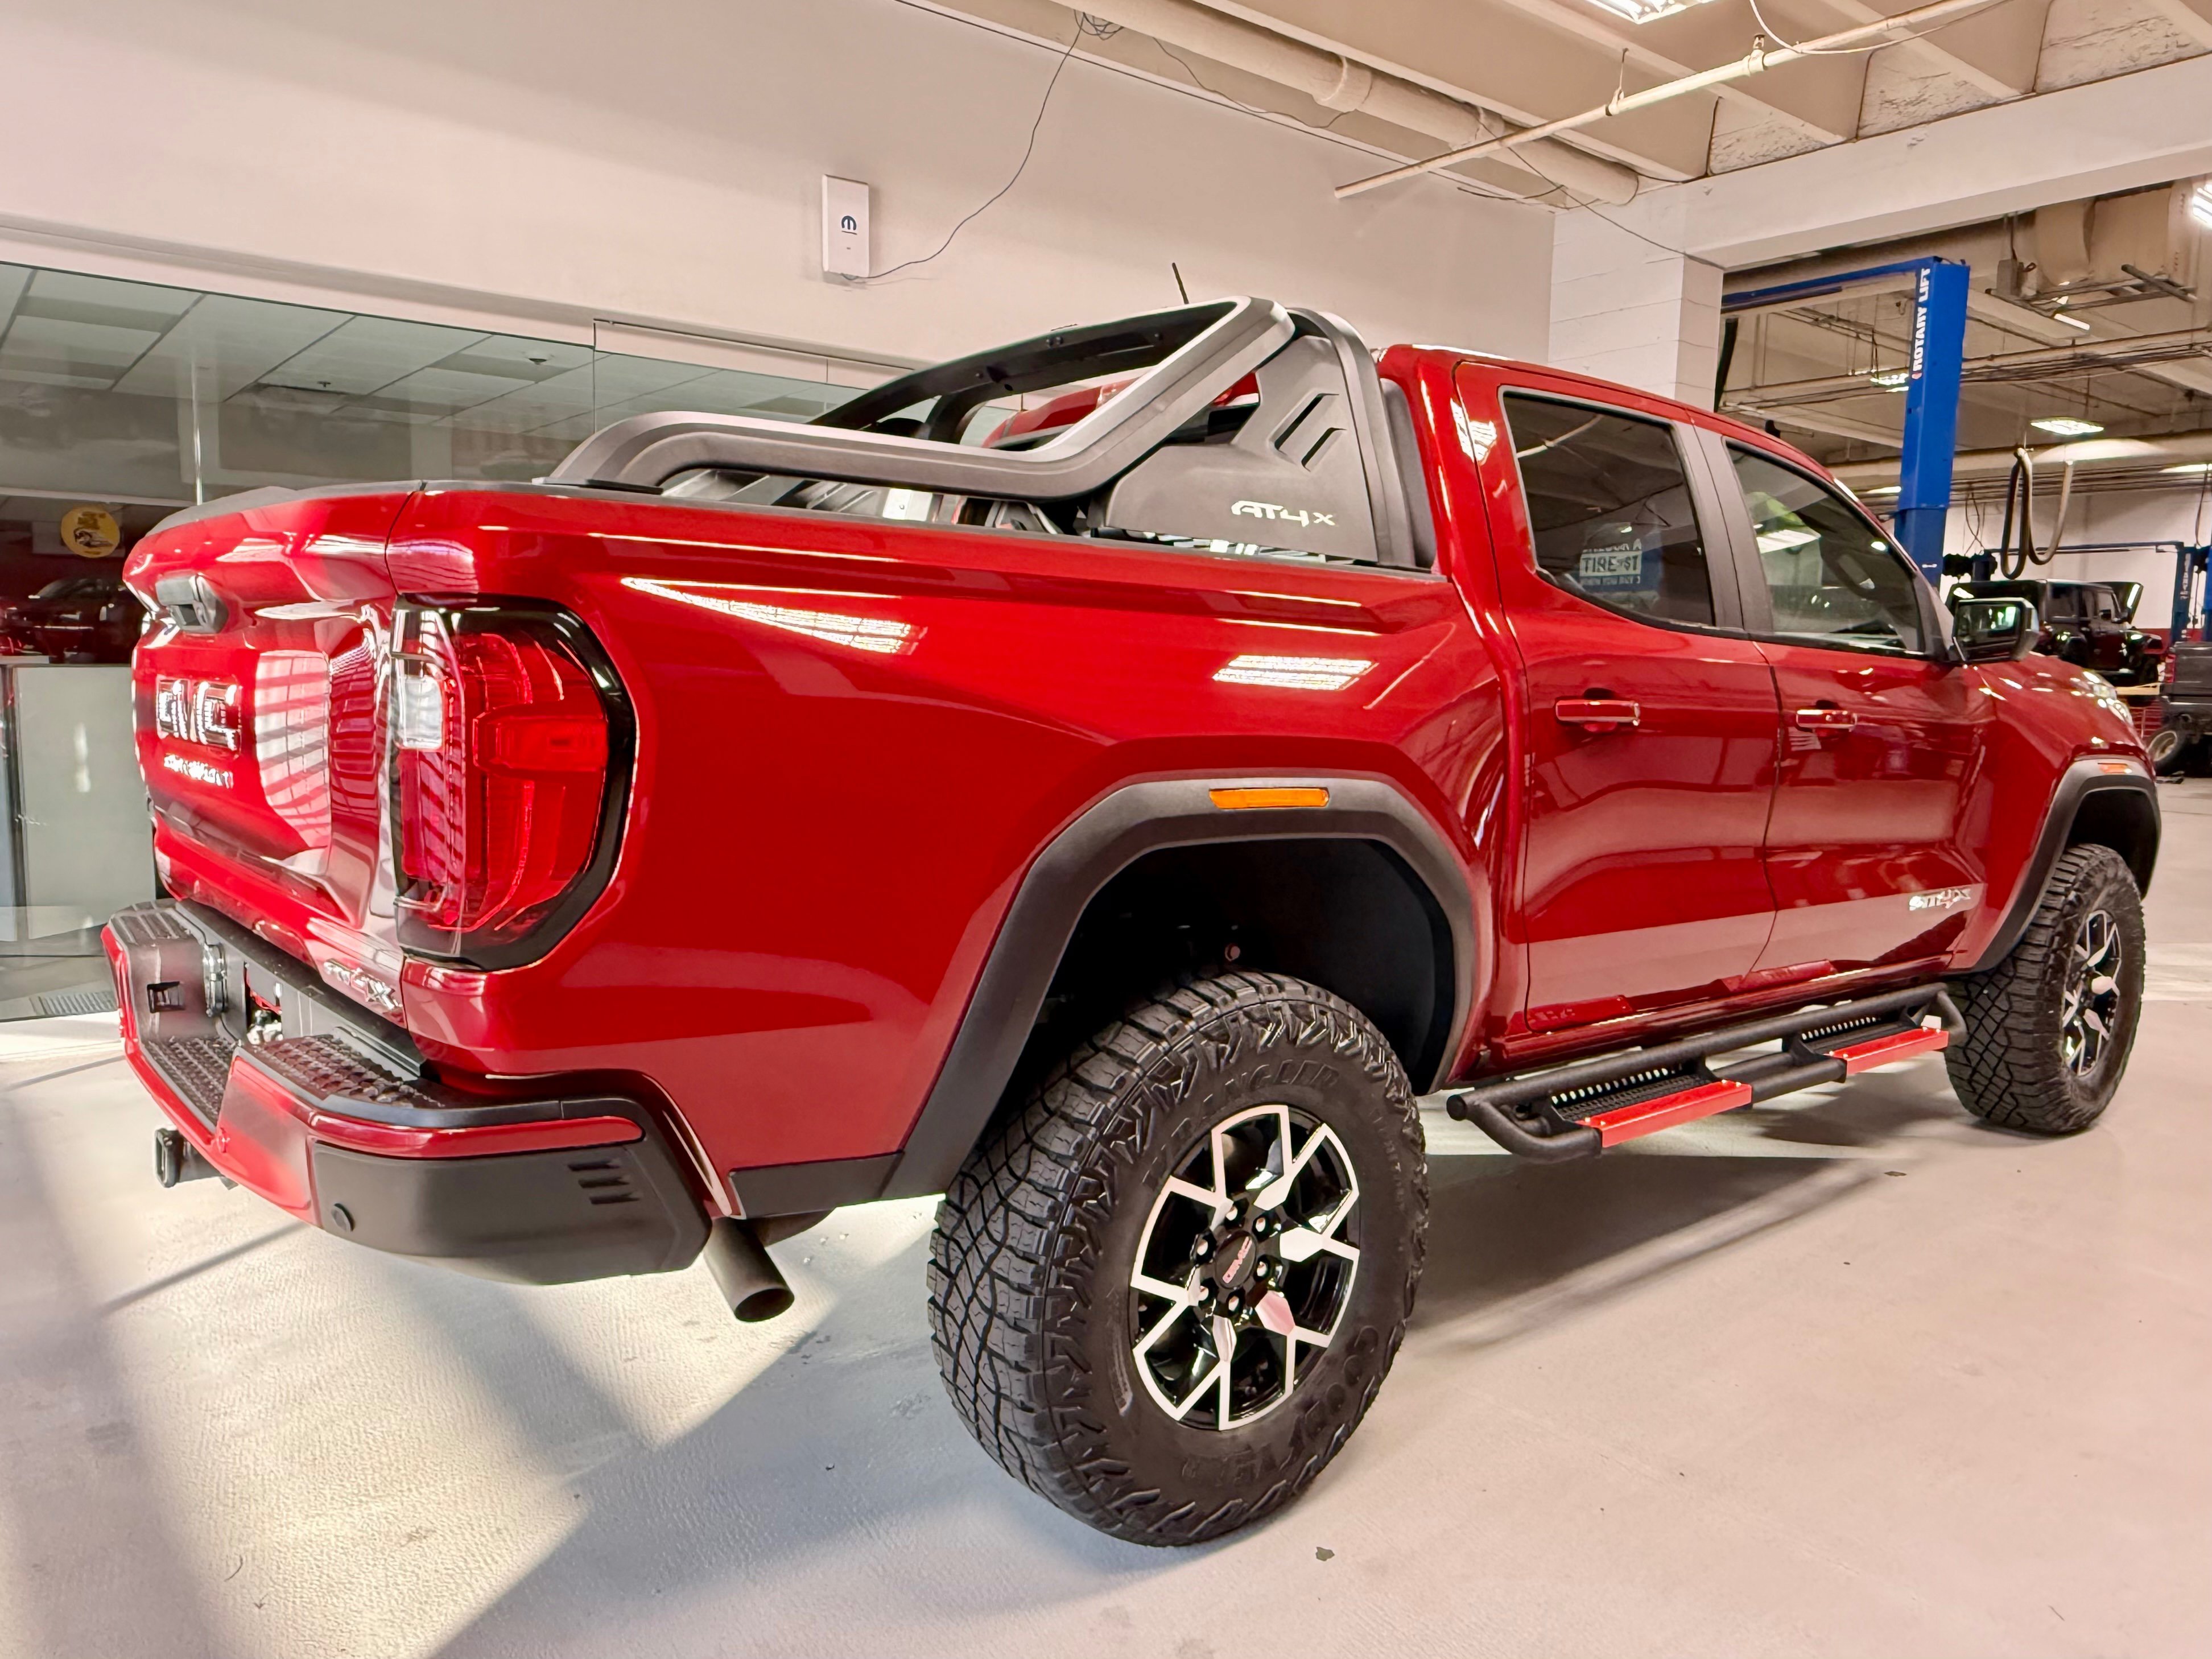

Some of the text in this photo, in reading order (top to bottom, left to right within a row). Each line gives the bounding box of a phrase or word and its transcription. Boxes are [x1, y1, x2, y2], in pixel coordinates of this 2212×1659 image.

[1912, 268, 1931, 372] ROTARY LIFT
[1582, 556, 1617, 573] TIRE
